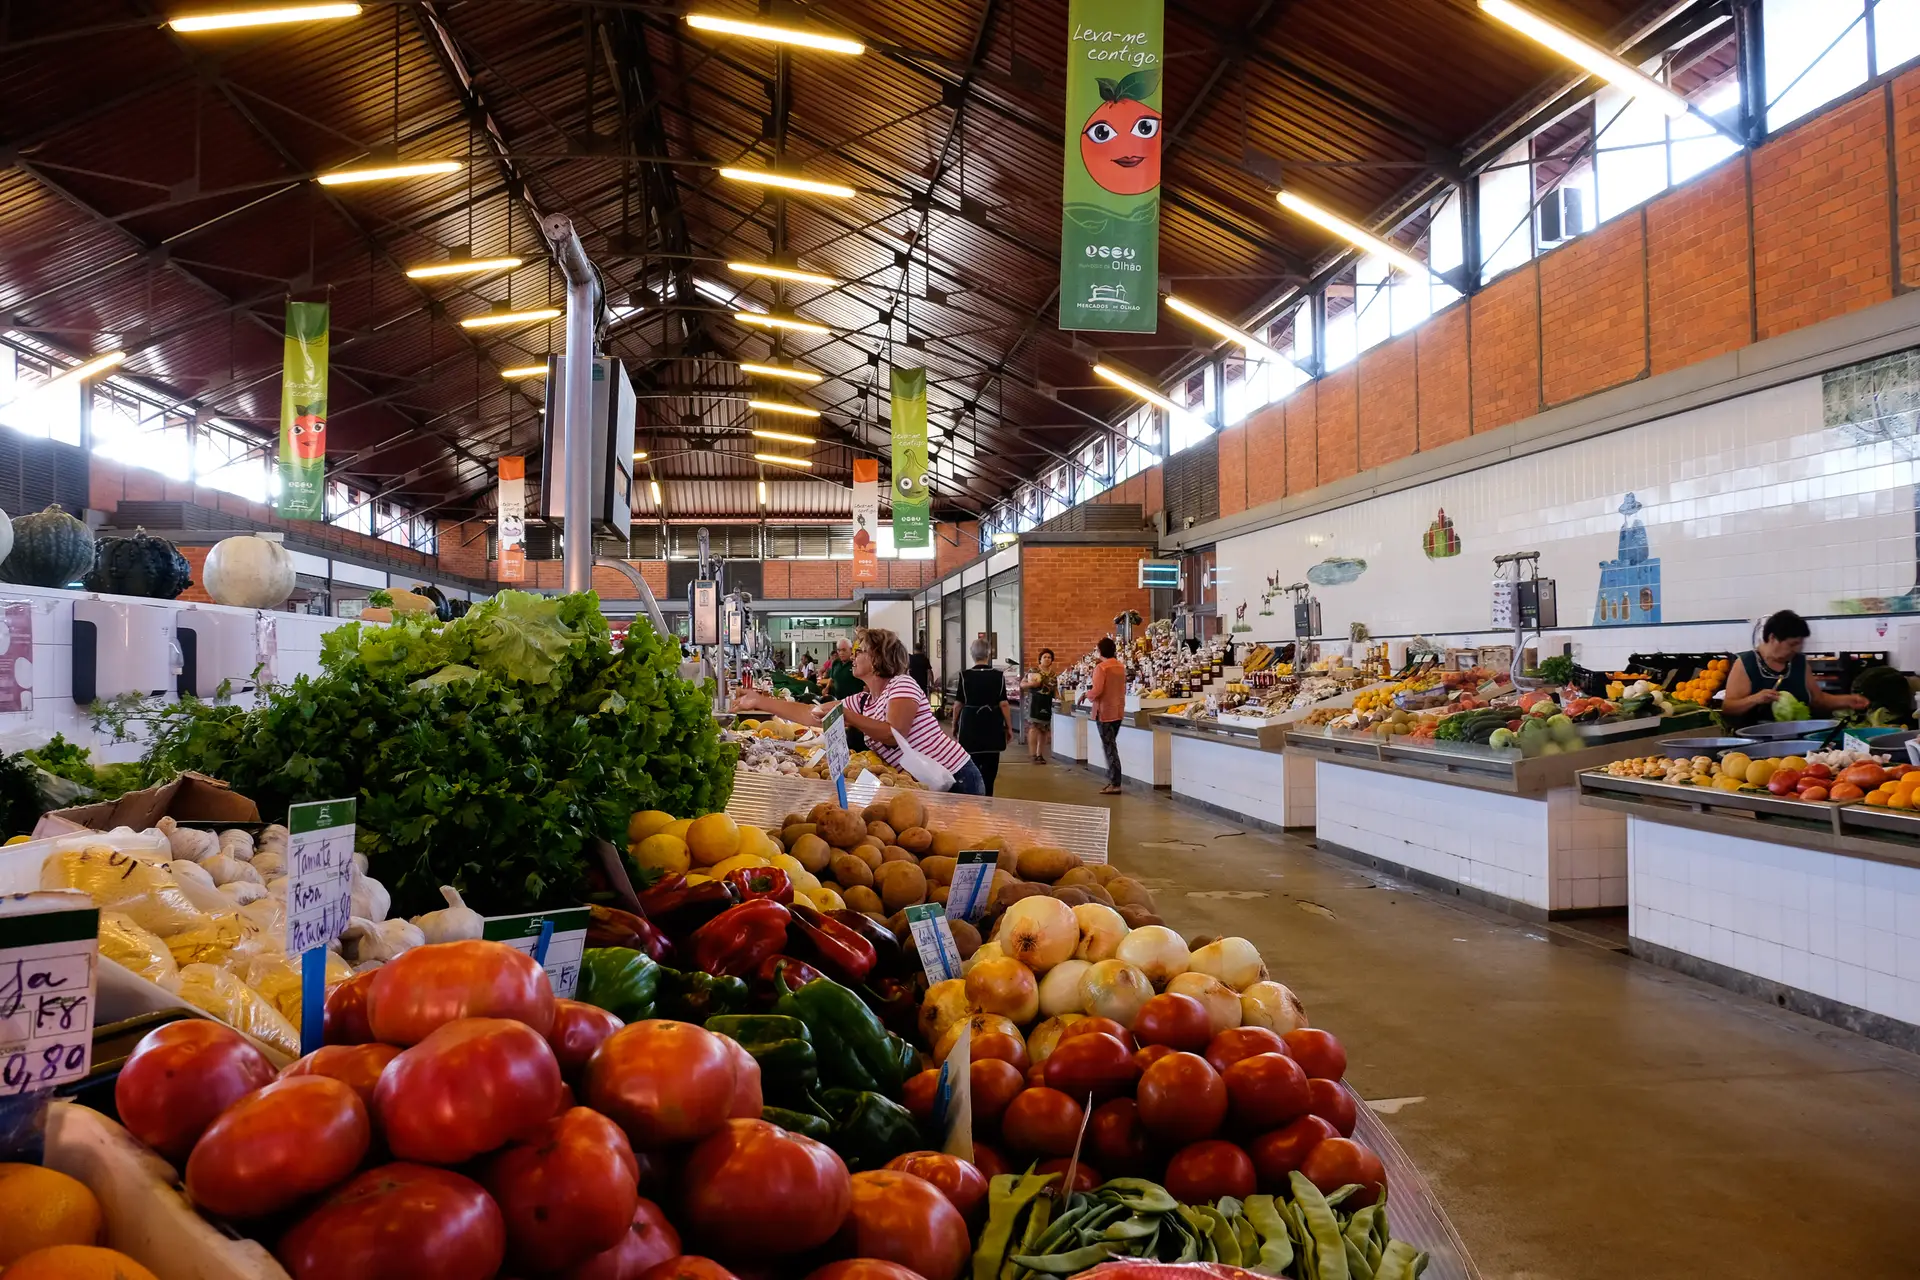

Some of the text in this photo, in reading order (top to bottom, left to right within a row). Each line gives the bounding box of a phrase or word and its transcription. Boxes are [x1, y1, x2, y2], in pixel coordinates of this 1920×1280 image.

[1073, 23, 1148, 44] Leva-me
[1087, 45, 1160, 67] contigo.
[3, 1043, 86, 1095] 0,80
